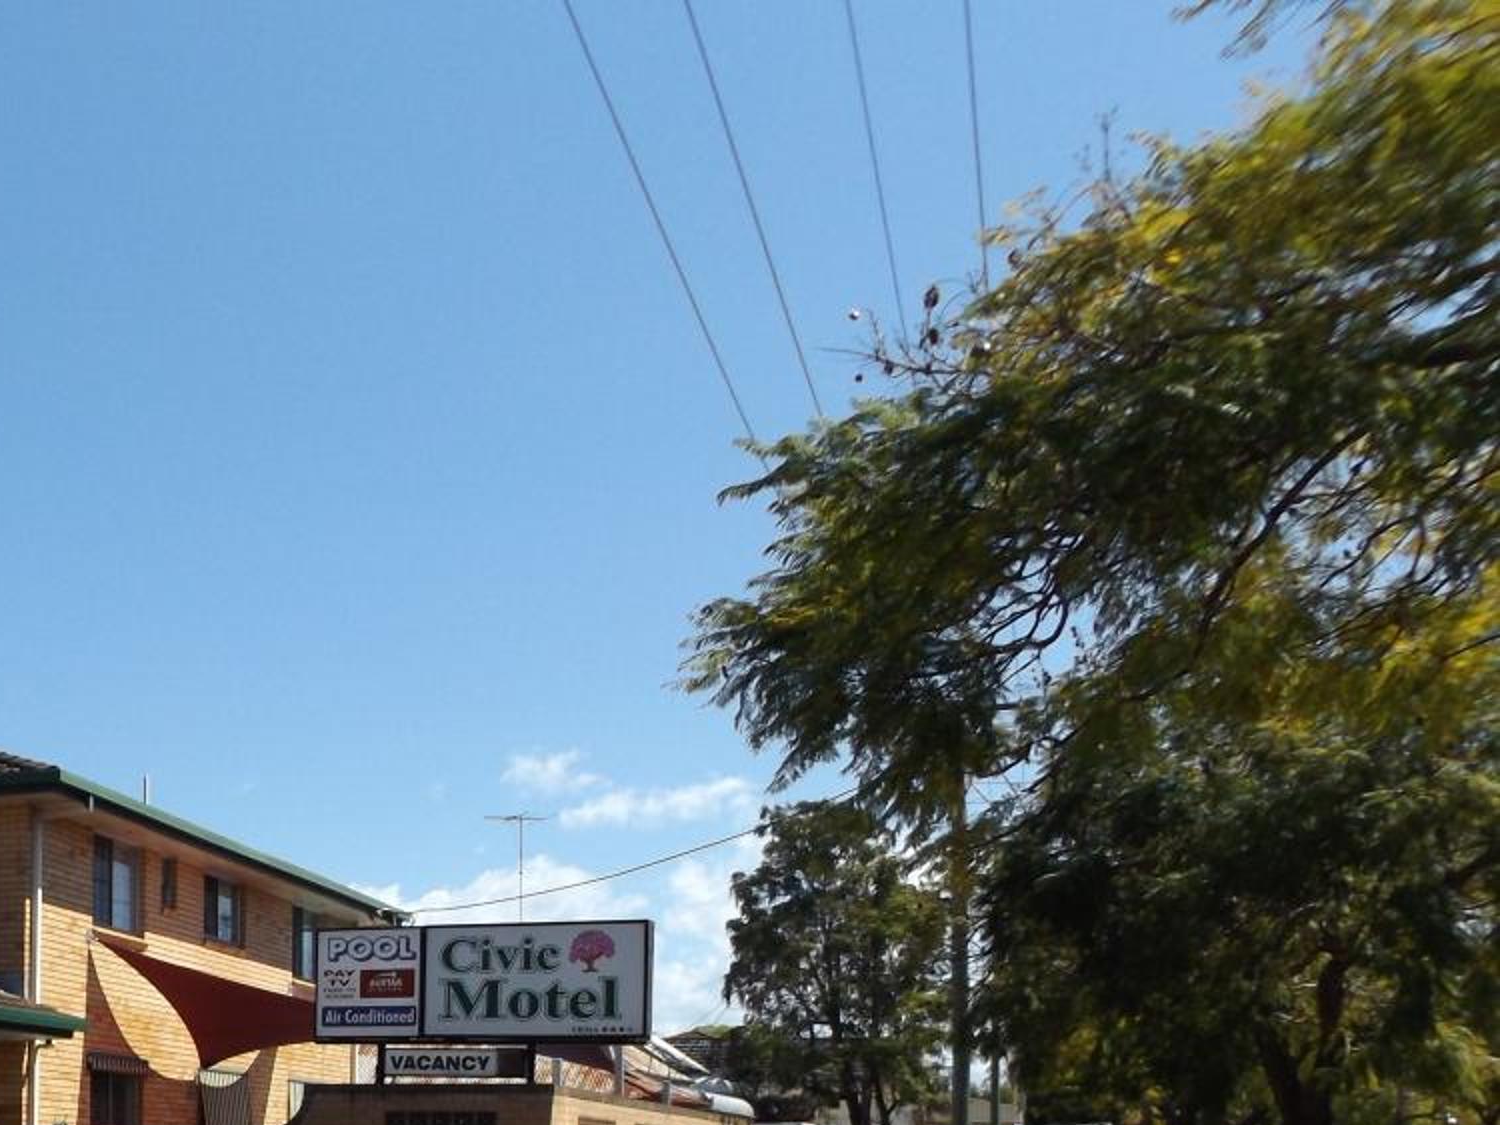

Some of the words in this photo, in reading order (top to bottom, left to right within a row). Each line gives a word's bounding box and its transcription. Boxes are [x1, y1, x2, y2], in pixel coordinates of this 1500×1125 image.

[327, 935, 416, 962] POOL
[440, 936, 560, 973] Civic
[323, 969, 356, 978] PAY
[329, 979, 350, 987] TV
[438, 976, 622, 1023] Motel
[325, 1009, 341, 1024] Air
[344, 1007, 415, 1025] Conditioned
[391, 1054, 491, 1072] VACANCY
